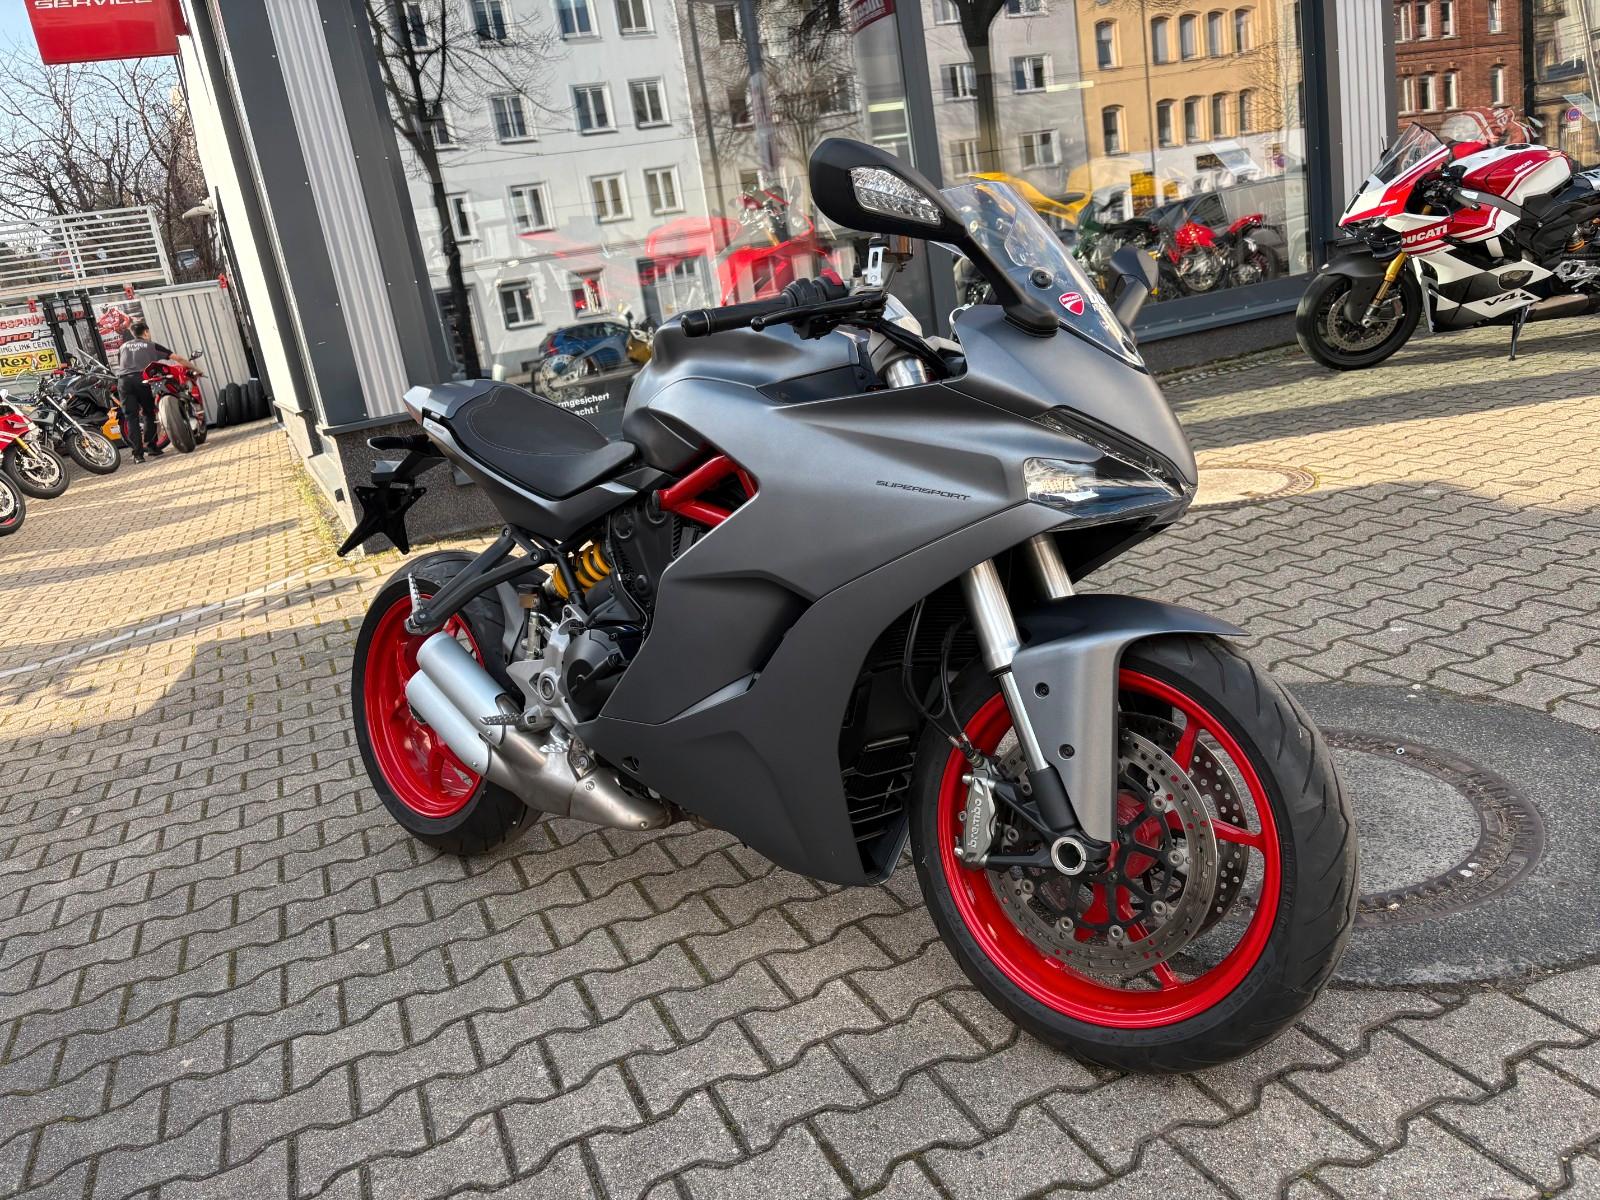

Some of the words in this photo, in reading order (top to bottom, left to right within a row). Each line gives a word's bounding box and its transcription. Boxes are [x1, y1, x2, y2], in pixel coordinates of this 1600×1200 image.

[34, 0, 154, 9] SERV
[876, 480, 971, 501] SUPERSPORT
[967, 798, 982, 849] brembo
